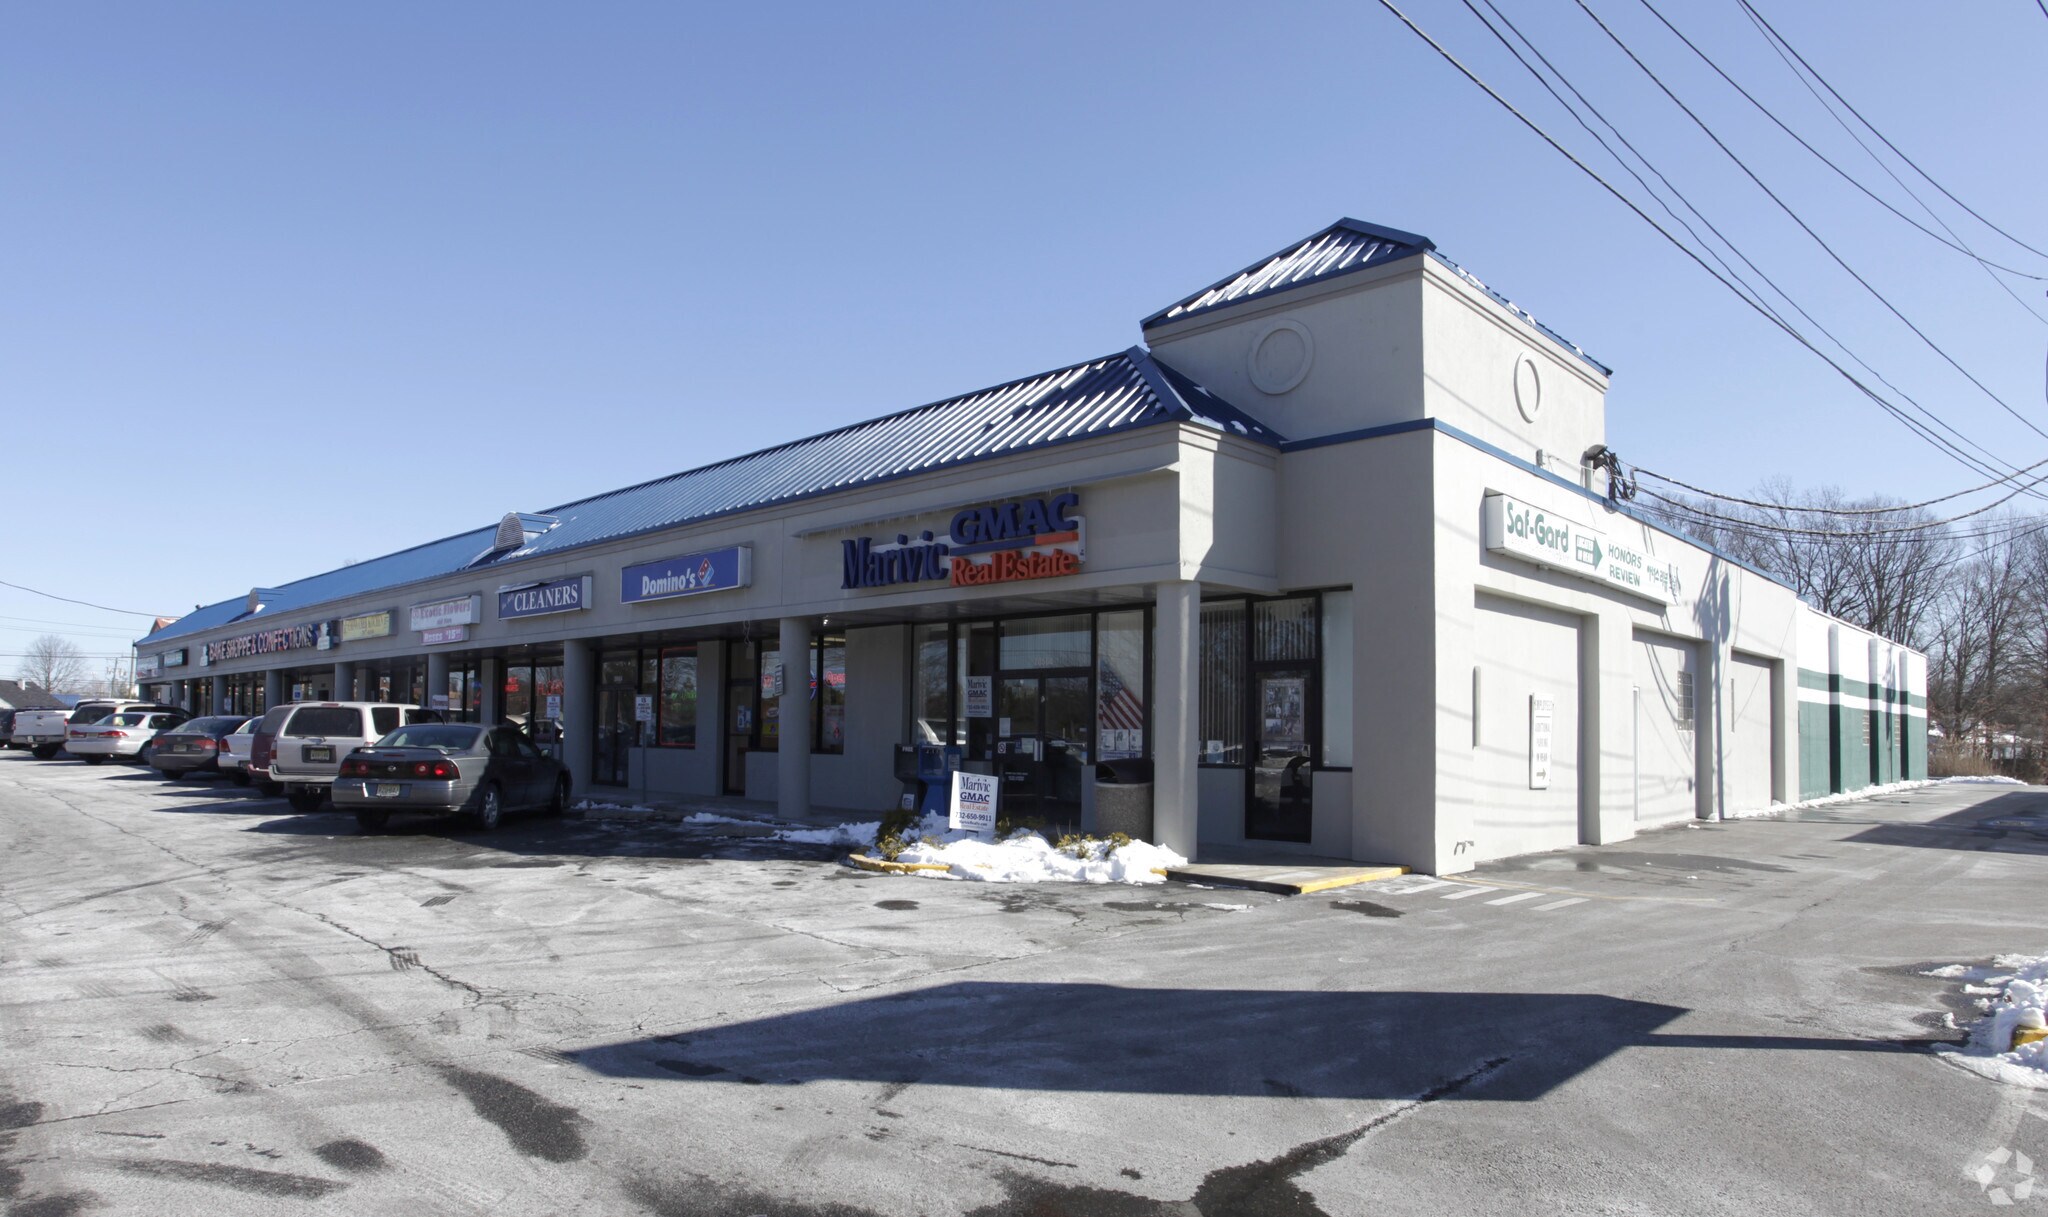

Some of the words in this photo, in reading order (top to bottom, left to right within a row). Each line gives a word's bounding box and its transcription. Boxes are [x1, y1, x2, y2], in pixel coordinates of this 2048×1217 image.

[951, 493, 1079, 545] GMAC
[1507, 501, 1569, 553] Saf-Gard
[841, 531, 949, 590] Marivic
[951, 553, 997, 587] Real
[1002, 549, 1079, 579] Estate
[1608, 544, 1642, 569] HONORS
[642, 568, 696, 595] Domino's
[1609, 564, 1641, 587] REVIEW
[420, 606, 442, 618] Exotic
[443, 600, 471, 614] Flowers
[514, 584, 578, 612] CLEANERS
[208, 642, 226, 662] BAKE
[226, 637, 251, 659] SHOPPE
[258, 624, 313, 653] CONFECTIONS
[960, 792, 990, 802] GMAC
[961, 776, 991, 792] Marivic
[956, 812, 992, 821] 732-650-9911
